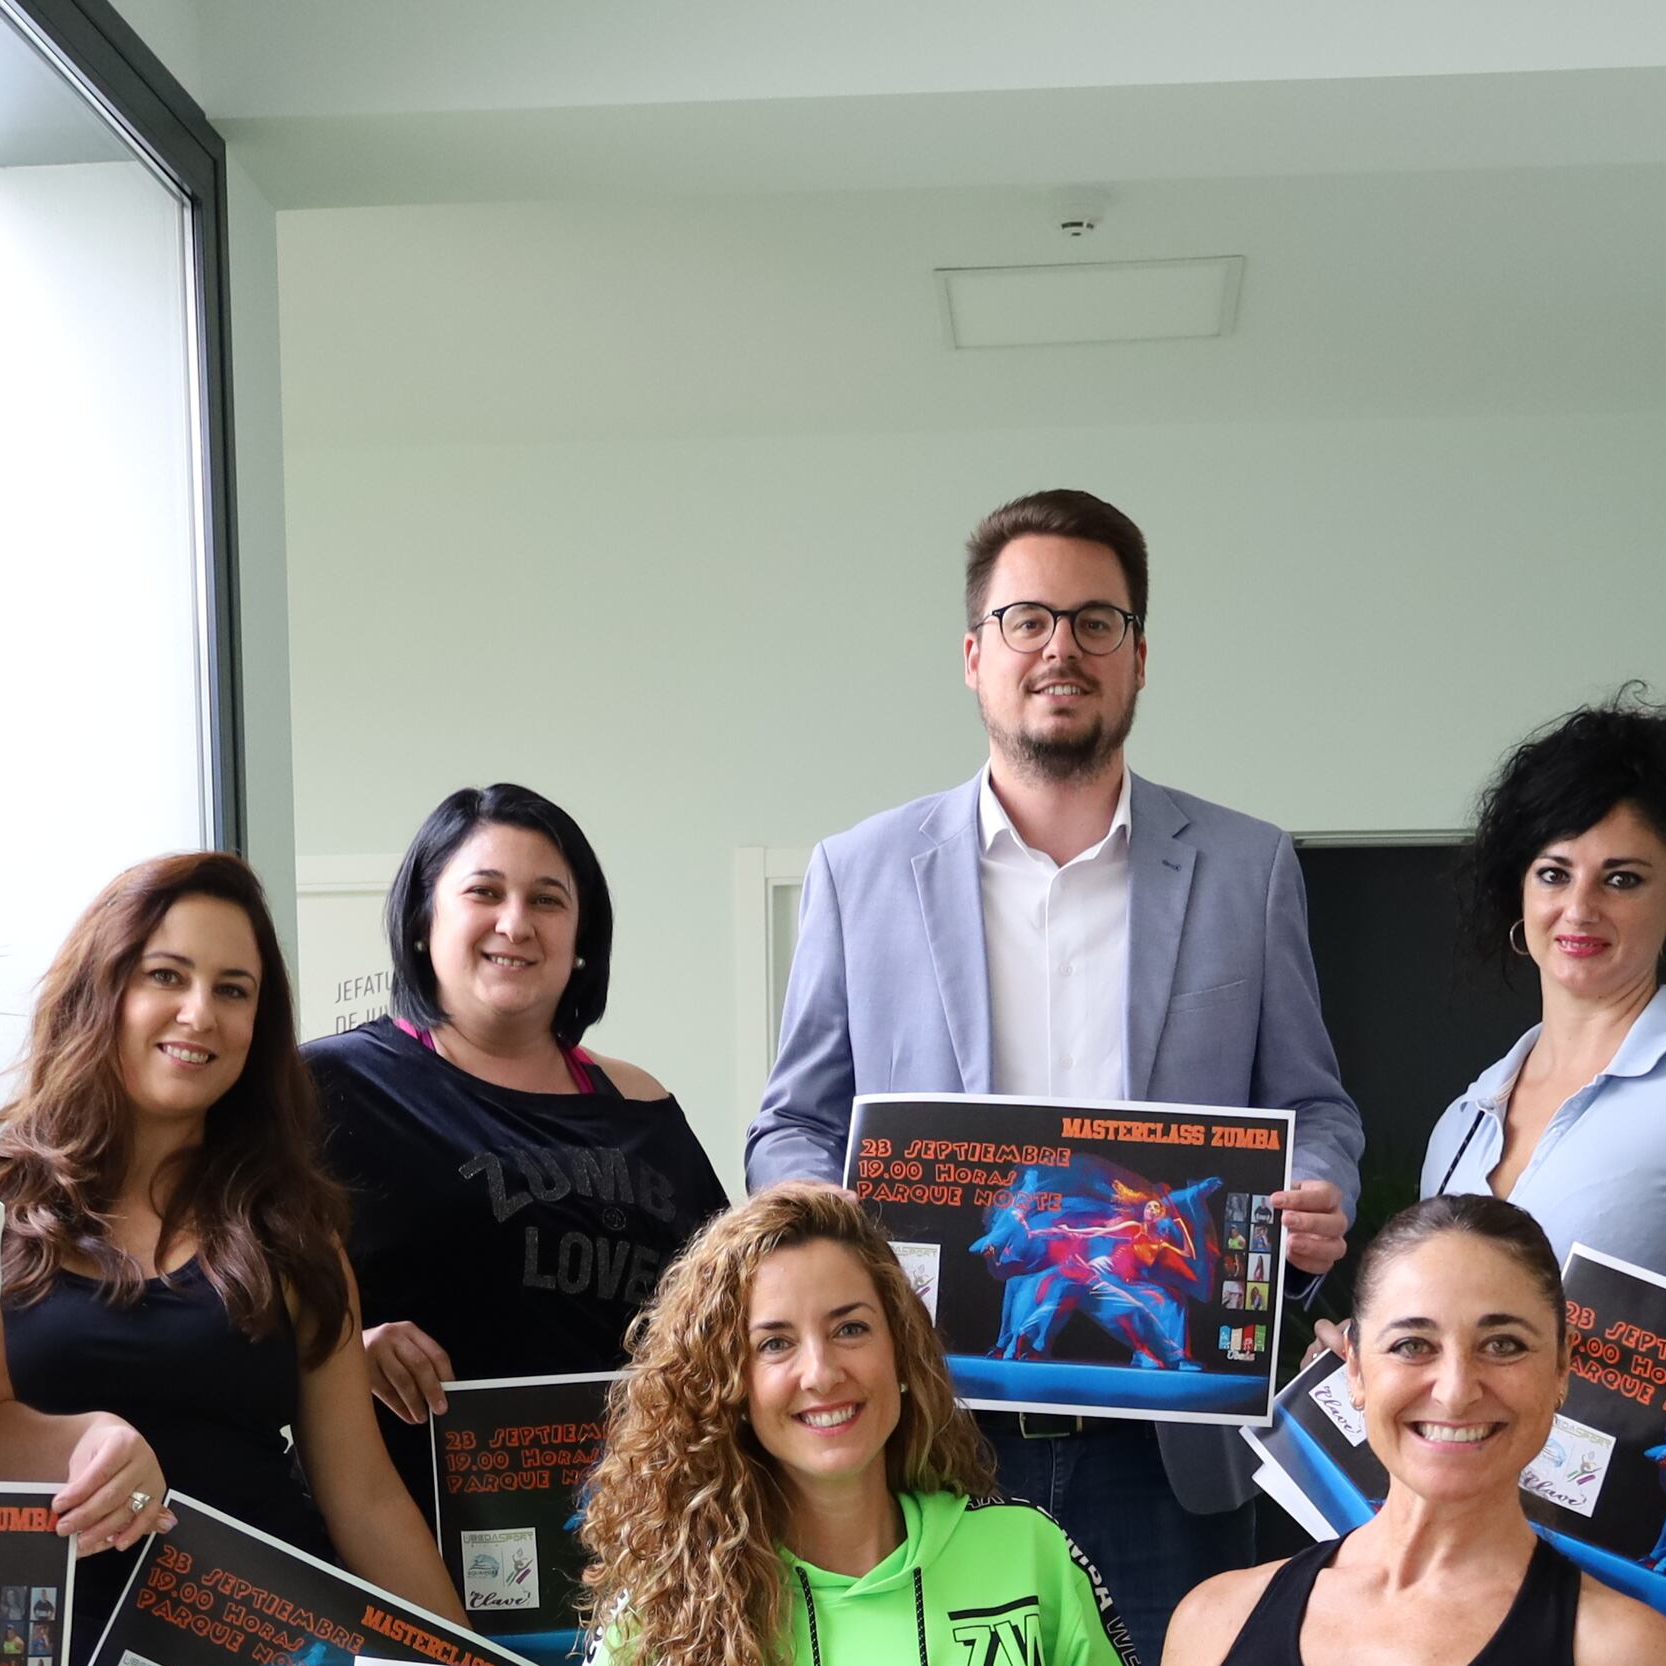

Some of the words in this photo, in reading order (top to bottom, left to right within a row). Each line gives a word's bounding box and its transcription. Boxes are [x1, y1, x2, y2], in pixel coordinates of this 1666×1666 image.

[1061, 1117, 1205, 1146] MASTERCLASS
[1211, 1126, 1280, 1151] ZUMBA
[860, 1138, 893, 1158] 23
[904, 1139, 1071, 1167] SEPTIEMBRE
[858, 1160, 923, 1181] 19.00
[935, 1164, 1018, 1187] HORAS
[856, 1180, 962, 1206] PARQUE
[973, 1188, 1062, 1213] NORTE
[1565, 1300, 1596, 1330] 23
[1569, 1355, 1656, 1405] ARQUE
[444, 1430, 477, 1450] 23
[445, 1454, 510, 1473] 19.00
[445, 1470, 551, 1494] PARQUE
[147, 1566, 215, 1612] 19.00
[223, 1600, 305, 1652] HORAS
[156, 1544, 193, 1575] 23
[202, 1567, 367, 1656] SEPTIEMBRE
[136, 1588, 246, 1653] PARQUE
